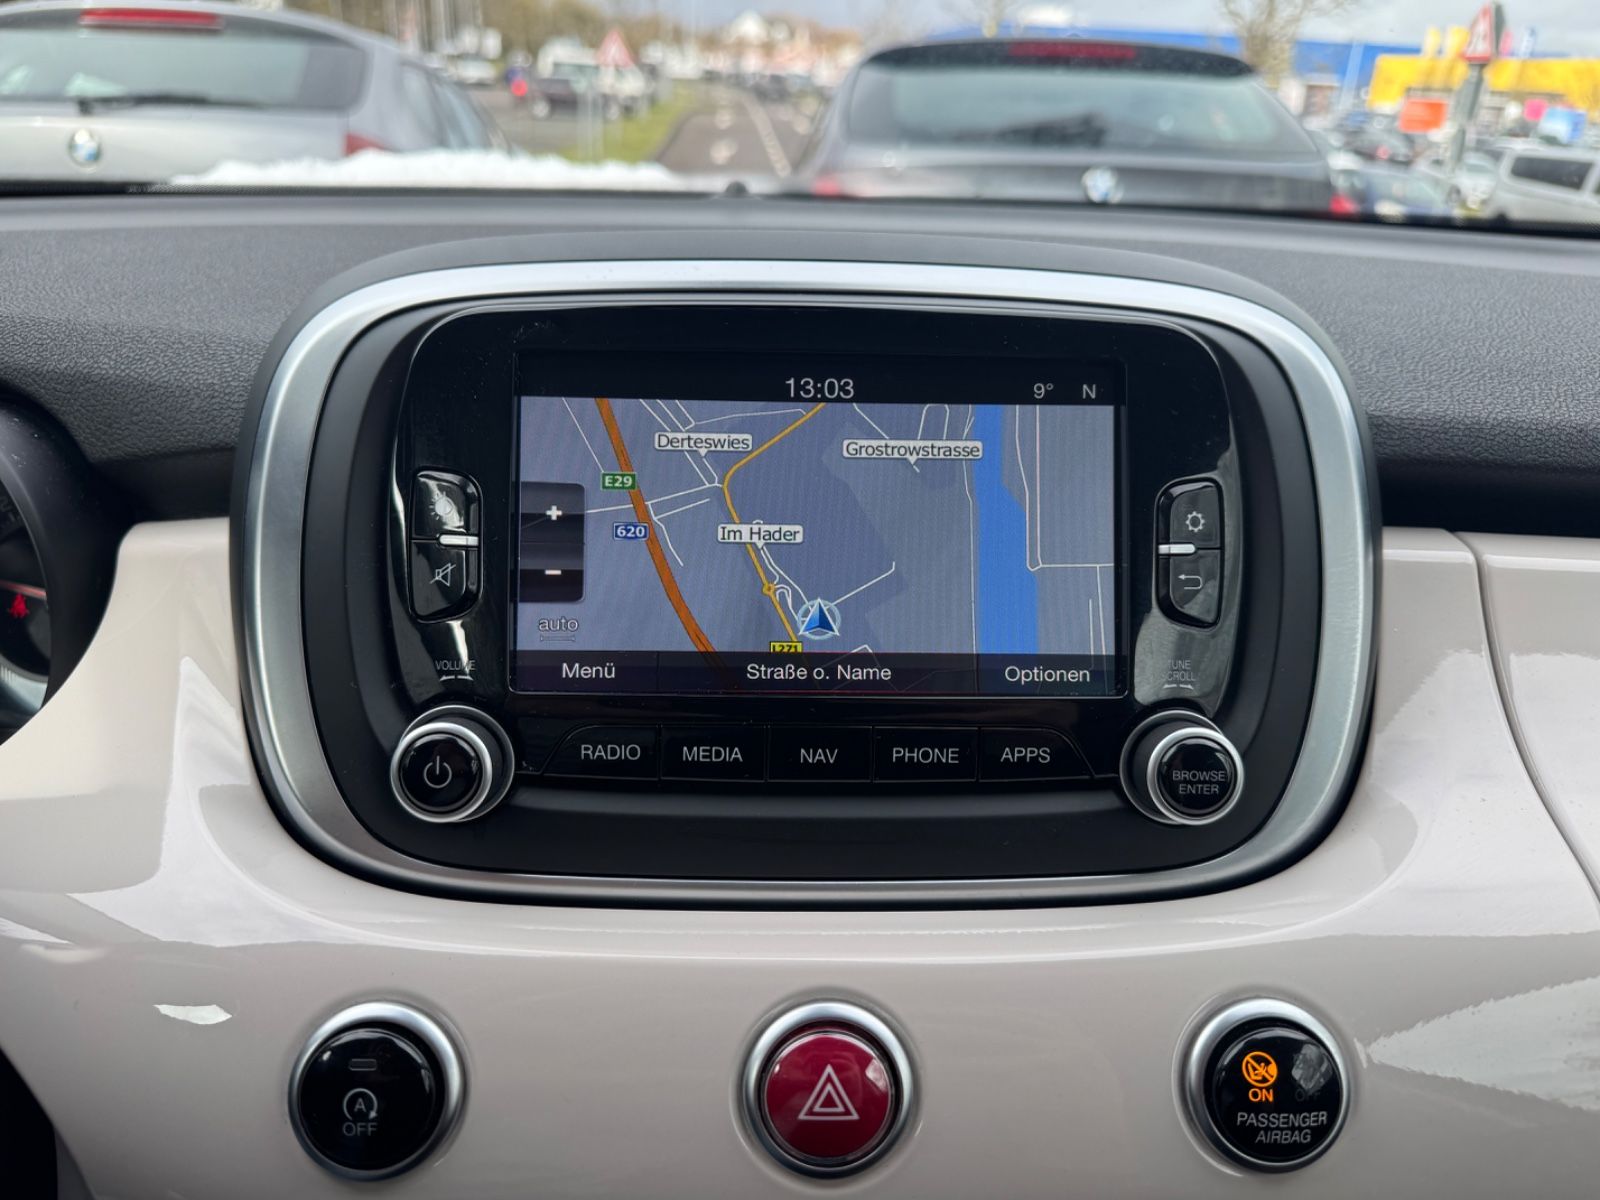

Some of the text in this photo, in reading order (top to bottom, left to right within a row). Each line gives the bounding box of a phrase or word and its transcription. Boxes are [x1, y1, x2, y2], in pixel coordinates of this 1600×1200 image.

[785, 378, 855, 399] 13:03
[1033, 383, 1054, 399] 9°
[1082, 384, 1096, 399] N
[657, 434, 750, 449] Derteswies
[845, 441, 980, 458] Grostrowstrasse
[604, 475, 633, 487] E29
[616, 526, 645, 538] 620
[720, 526, 800, 541] Im Hader
[538, 616, 579, 632] auto
[562, 663, 615, 679] Menü
[746, 663, 892, 680] Straße o. Name
[1167, 659, 1191, 670] TUNE
[1004, 665, 1090, 685] Optionen
[580, 744, 641, 760] RADIO
[682, 746, 743, 762] MEDIA
[800, 748, 838, 763] NAV
[892, 747, 960, 763] PHONE
[1000, 747, 1050, 763] APPS
[1172, 770, 1226, 781] BROWSE
[1179, 783, 1219, 795] ENTER
[1248, 1088, 1274, 1102] ON
[354, 1098, 366, 1112] A
[1236, 1111, 1327, 1128] PASSENGER
[342, 1122, 378, 1136] OFF
[1255, 1129, 1312, 1144] AIRBAG
